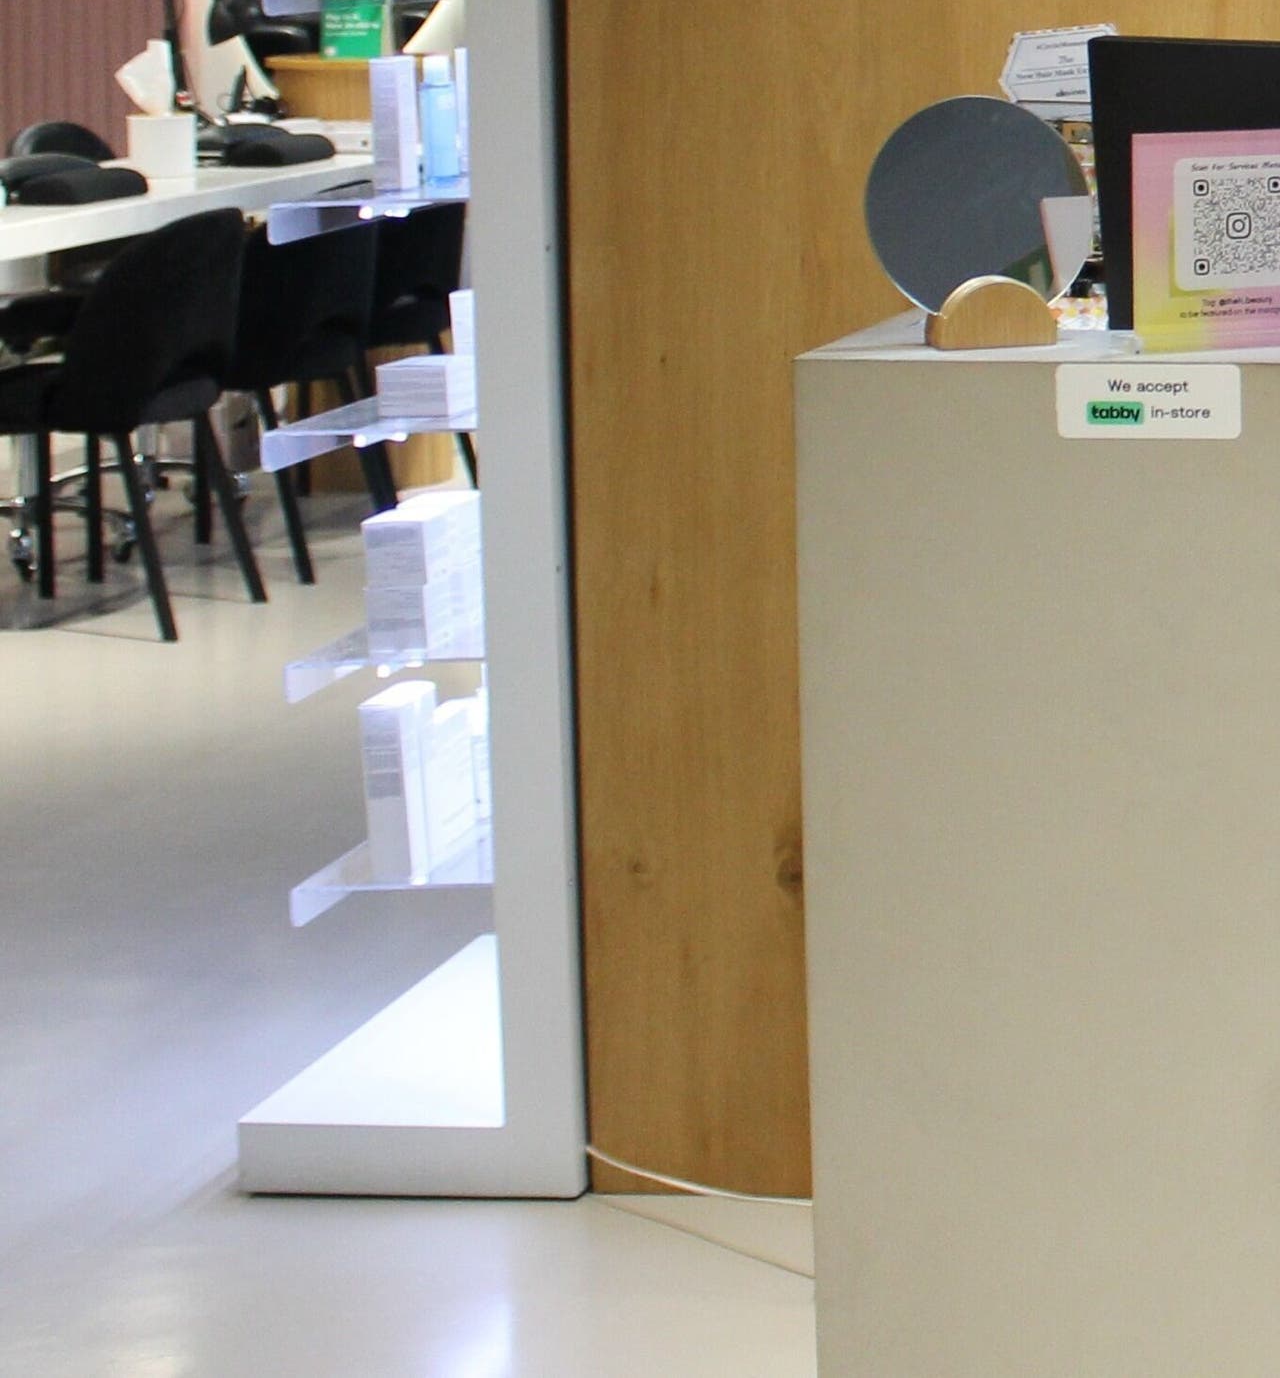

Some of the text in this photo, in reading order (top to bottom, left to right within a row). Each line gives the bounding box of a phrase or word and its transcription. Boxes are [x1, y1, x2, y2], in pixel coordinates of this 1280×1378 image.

[1108, 380, 1189, 396] We accept
[1091, 405, 1211, 422] tabby in-store
